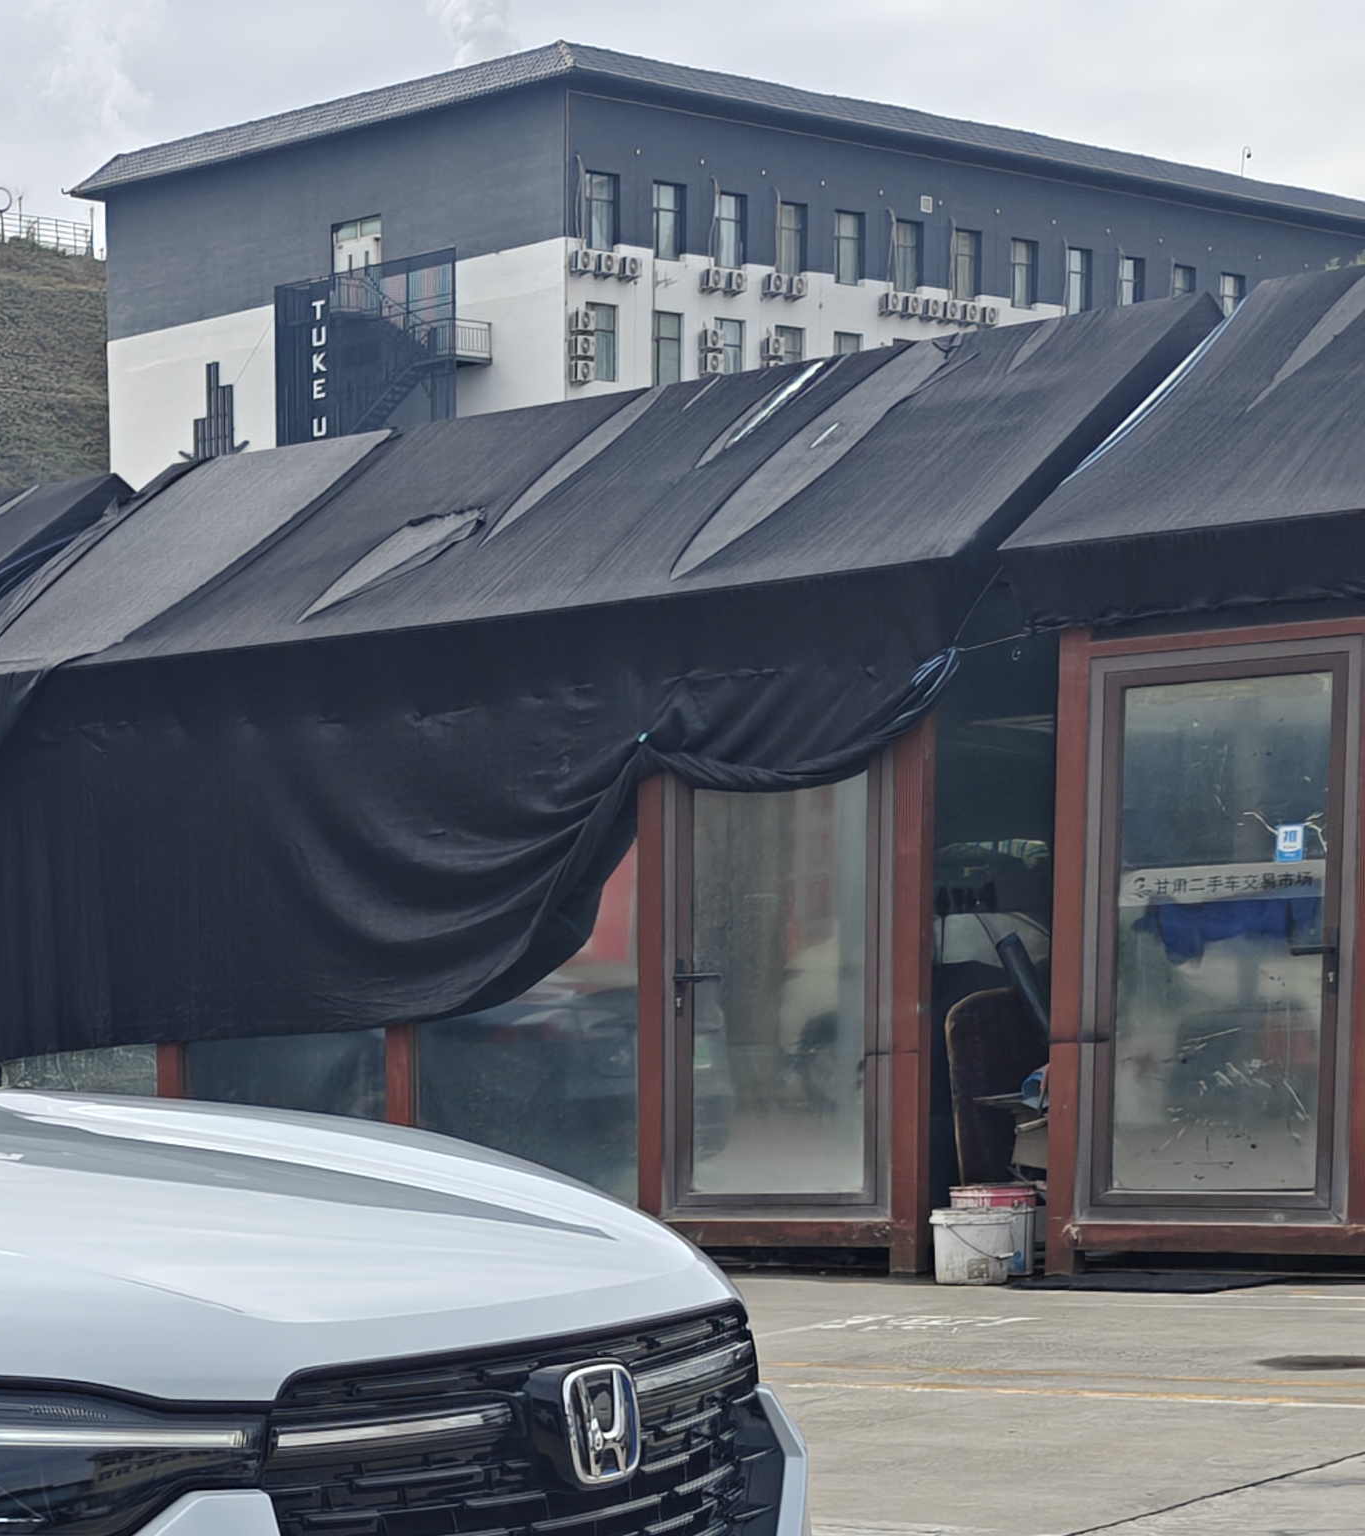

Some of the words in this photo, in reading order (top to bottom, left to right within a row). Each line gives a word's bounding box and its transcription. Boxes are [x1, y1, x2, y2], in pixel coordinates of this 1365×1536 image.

[311, 300, 328, 400] TUKE
[1153, 871, 1314, 895] 甘肃二手车交易市场
